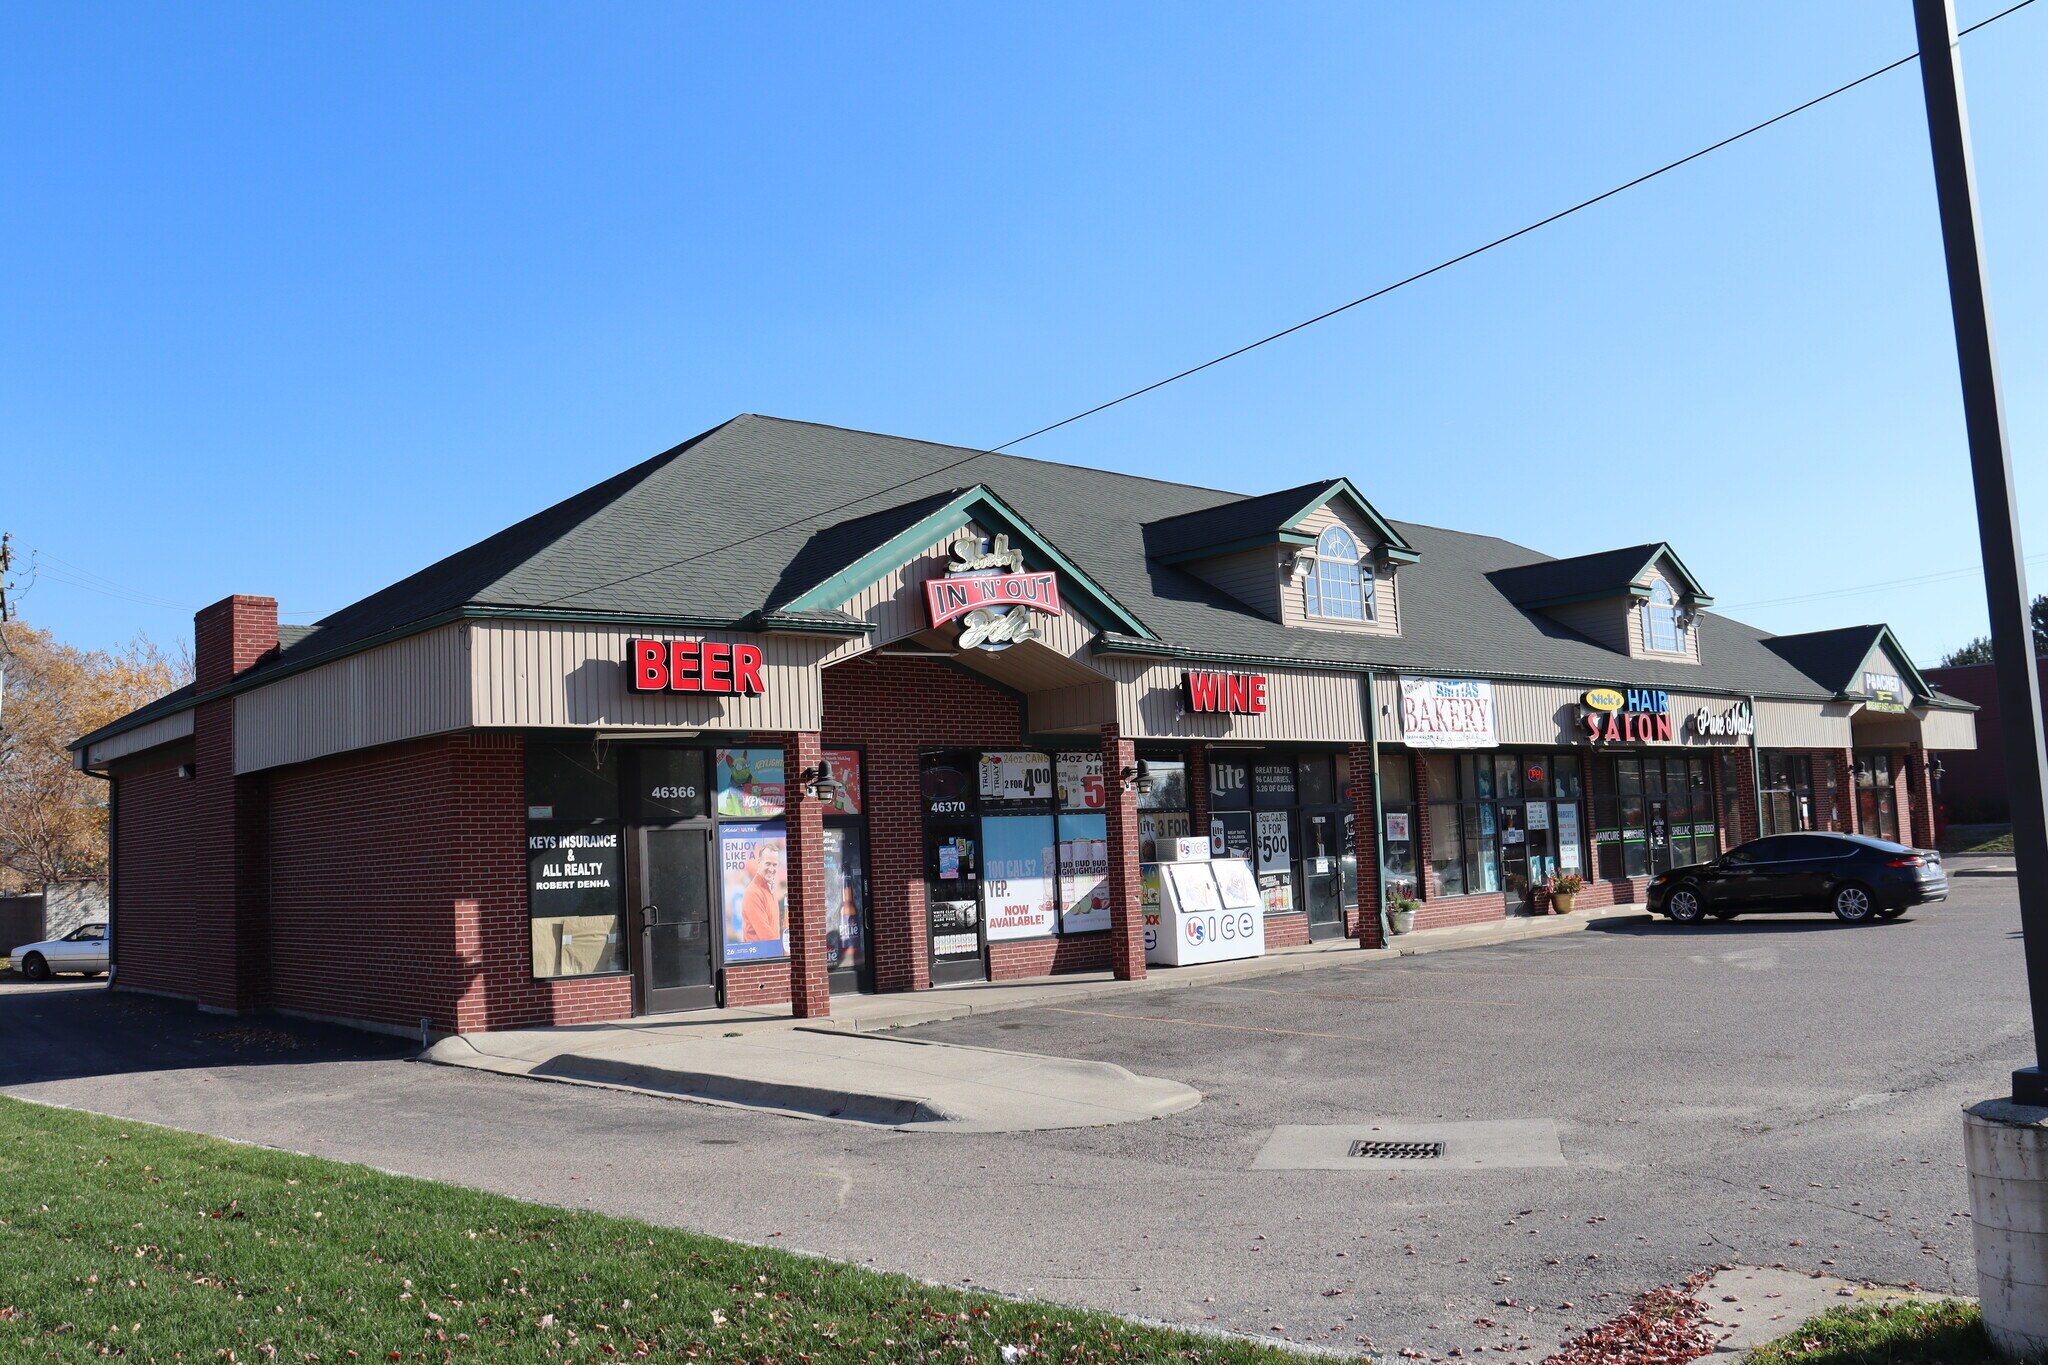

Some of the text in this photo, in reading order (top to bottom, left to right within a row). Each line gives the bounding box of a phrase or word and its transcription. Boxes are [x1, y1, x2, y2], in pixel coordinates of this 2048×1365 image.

[934, 582, 969, 616] IN
[1005, 574, 1052, 605] OUT
[633, 638, 766, 694] BEER
[1188, 671, 1267, 713] WINE
[1591, 689, 1669, 712] Nick's HAIR
[1404, 697, 1489, 732] BAKERY
[1697, 706, 1725, 735] Pure
[1587, 711, 1672, 742] SALON
[1003, 753, 1049, 764] 24oz CANS
[1056, 753, 1083, 763] 24oz
[1086, 765, 1093, 775] 2
[1004, 780, 1010, 789] 2
[1011, 780, 1023, 789] FOR
[1209, 763, 1292, 797] Lite GREAT TASTE.
[1263, 775, 1291, 783] CALORIES.
[651, 786, 696, 799] 46366
[1276, 784, 1296, 792] CARBS.
[931, 801, 966, 812] 46370
[1140, 821, 1155, 835] Lite
[1158, 818, 1189, 837] 3 FOR
[1212, 827, 1223, 837] Lite
[1262, 823, 1282, 834] 3 FOR
[1671, 826, 1691, 835] SHELLAC
[529, 834, 617, 849] KEYS INSURANCE
[725, 841, 757, 851] ENJOY
[1191, 841, 1209, 854] ice
[567, 849, 575, 861] &
[1257, 835, 1288, 863] $500
[725, 851, 756, 860] LIKE A
[542, 862, 603, 877] ALL REALTY
[726, 861, 746, 870] PRO
[987, 860, 1005, 878] 100
[1006, 859, 1037, 877] CALS?
[1074, 860, 1090, 868] BUD
[536, 879, 610, 890] ROBERT DENHA
[987, 880, 1010, 898] YEP.
[1004, 904, 1029, 916] NOW
[989, 914, 1045, 929] AVAILABLE!
[1145, 915, 1160, 926] XX
